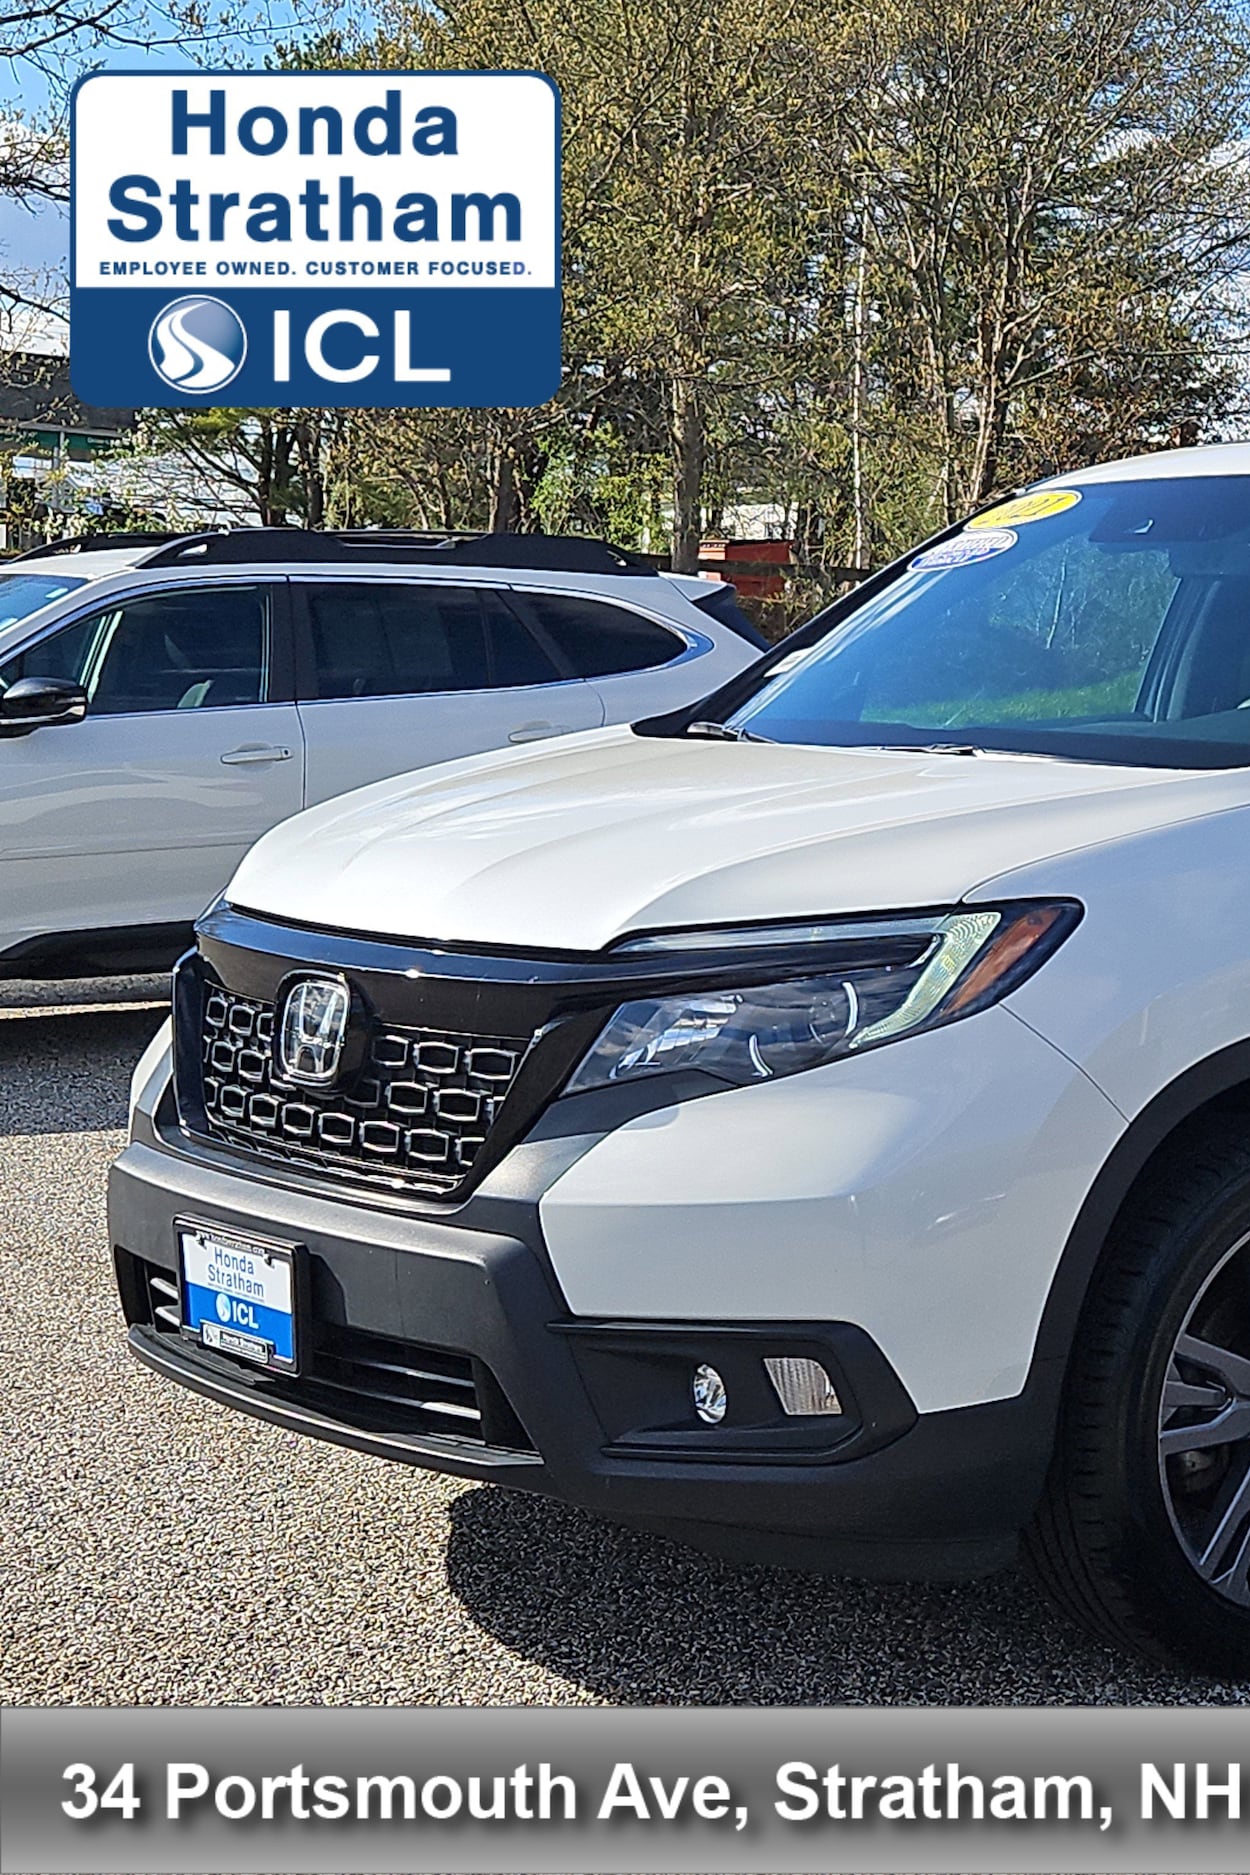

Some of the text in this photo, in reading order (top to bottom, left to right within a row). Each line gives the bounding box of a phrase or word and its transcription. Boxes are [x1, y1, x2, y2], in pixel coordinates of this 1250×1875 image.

[214, 1246, 255, 1275] Honda
[207, 1263, 265, 1298] Stratham
[232, 1300, 259, 1330] ICL
